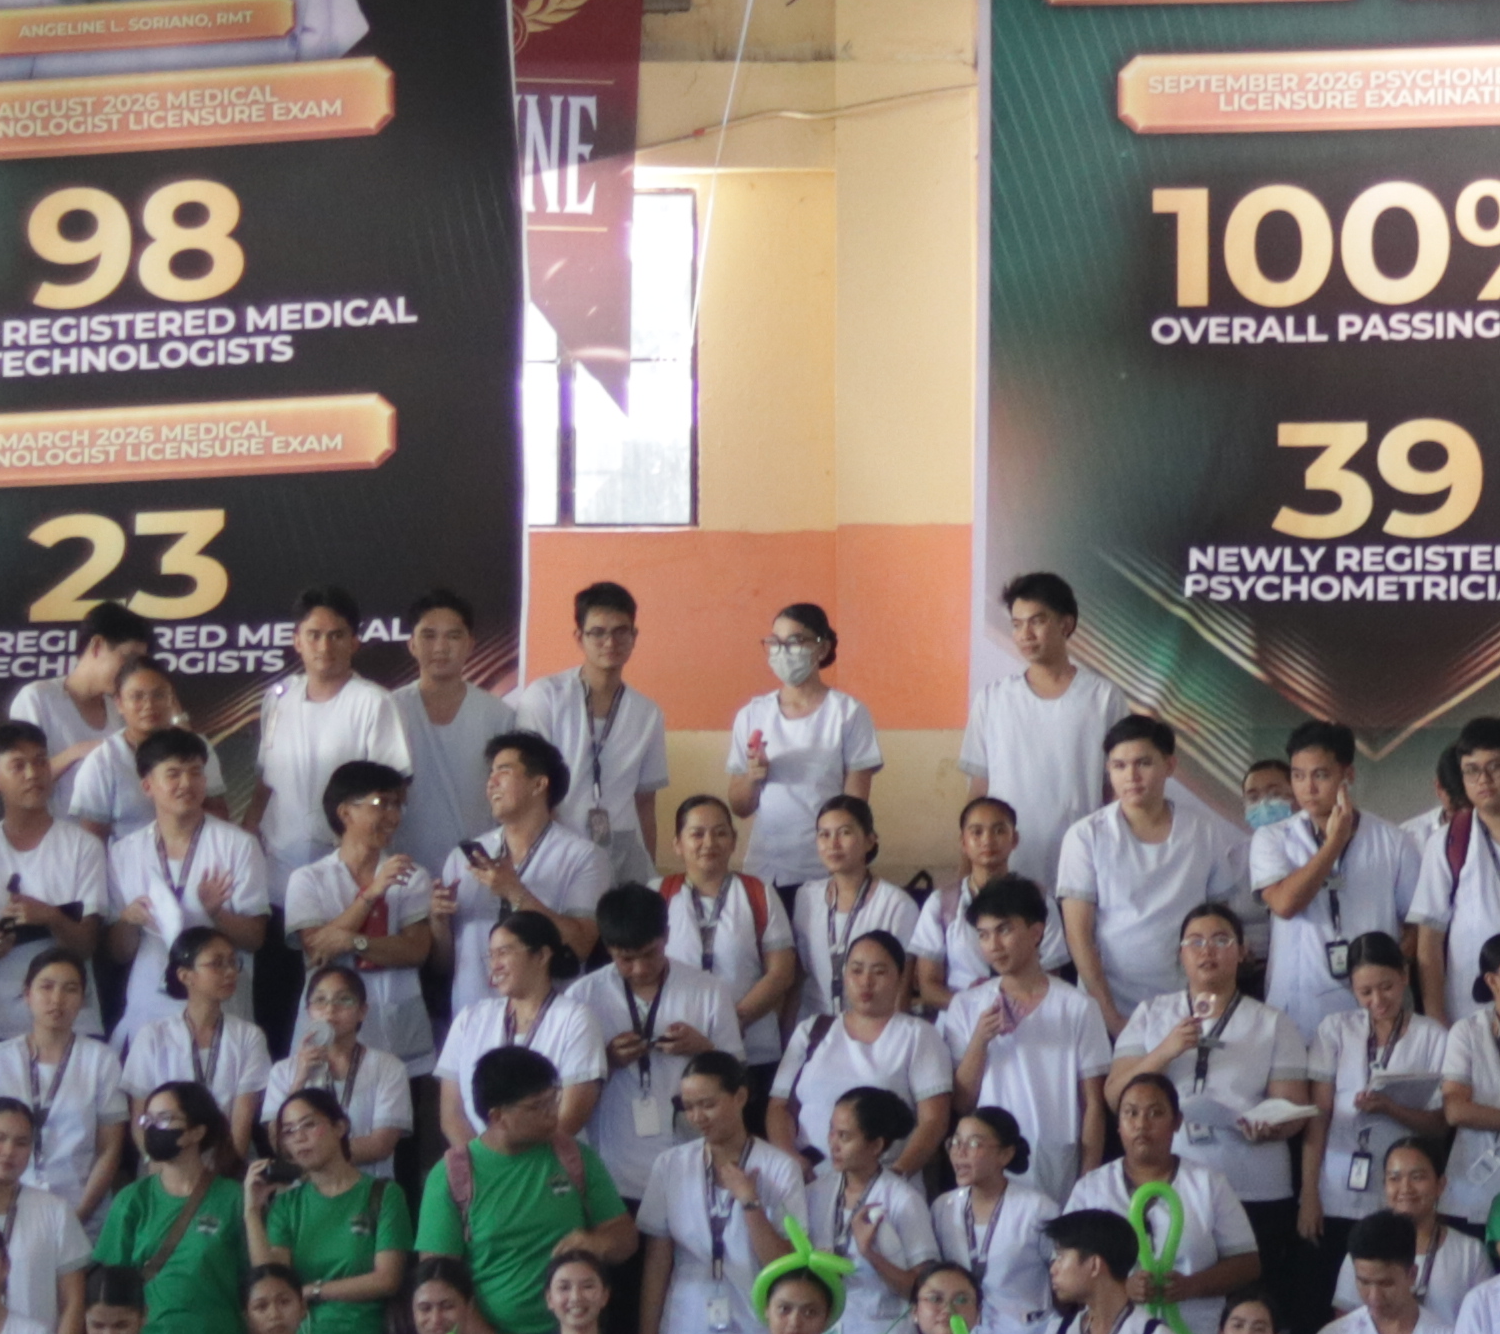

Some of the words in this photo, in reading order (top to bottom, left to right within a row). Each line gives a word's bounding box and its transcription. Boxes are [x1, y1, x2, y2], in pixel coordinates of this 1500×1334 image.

[18, 17, 105, 39] ANGELINE
[110, 16, 123, 34] L.
[128, 12, 211, 33] SORIANO,
[216, 9, 253, 28] RMT
[1148, 71, 1301, 93] SEPTEMBER
[1307, 70, 1362, 90] 2026
[103, 90, 160, 115] 2026
[167, 83, 278, 111] MEDICAL
[129, 102, 266, 132] LICENSURE
[273, 97, 342, 123] EXAM
[1219, 89, 1358, 112] LICENSURE
[25, 179, 244, 309] 98
[2, 307, 235, 348] REGISTERED
[246, 297, 417, 335] MEDICAL
[1152, 313, 1328, 345] OVERALL
[1338, 310, 1500, 340] PASSING
[95, 424, 155, 446] 2026
[161, 419, 272, 444] MEDICAL
[127, 437, 266, 464] LICENSURE
[272, 433, 342, 457] EXAM
[1272, 418, 1483, 538] 39
[27, 508, 228, 622] 23
[1189, 545, 1326, 572] NEWLY
